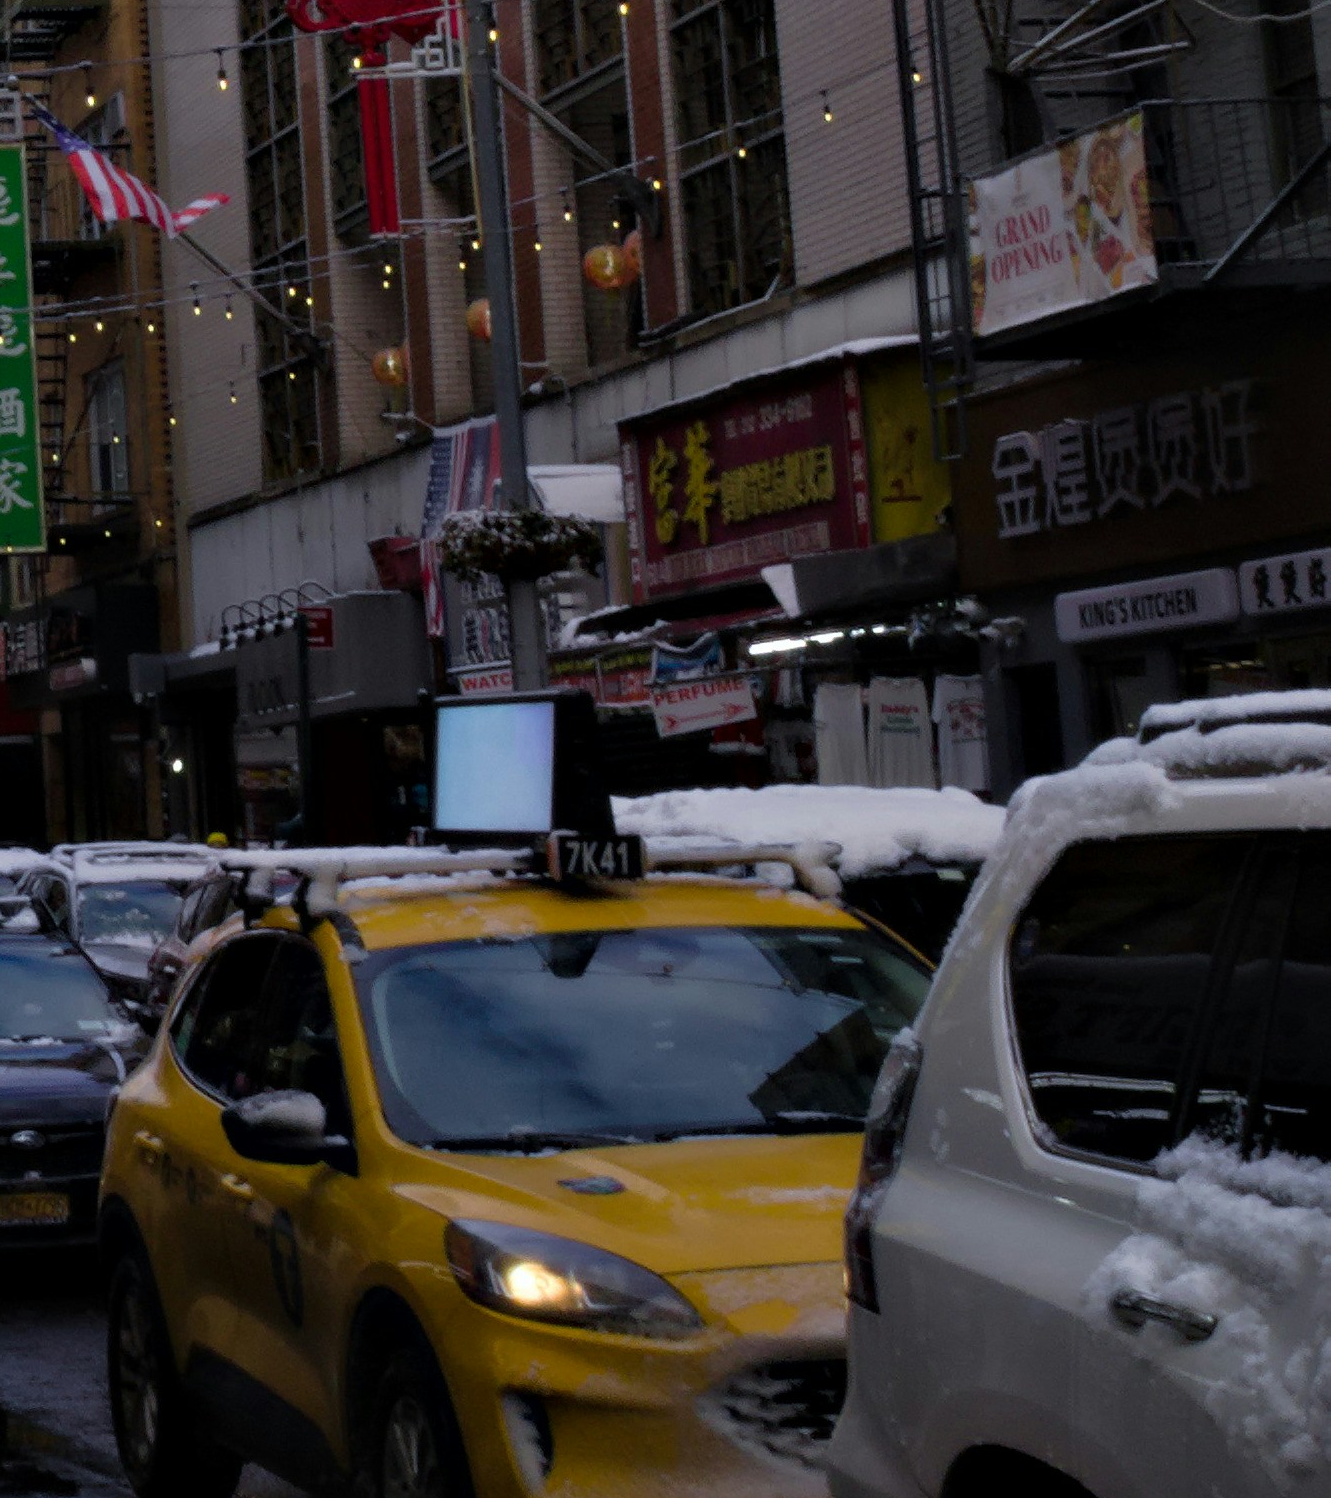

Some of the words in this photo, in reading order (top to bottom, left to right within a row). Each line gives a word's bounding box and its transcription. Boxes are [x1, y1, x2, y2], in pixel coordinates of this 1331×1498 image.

[994, 204, 1051, 248] GRAND
[991, 234, 1063, 285] OPENING
[1078, 595, 1130, 629] KING'S
[1131, 587, 1199, 622] KITCHEN
[652, 677, 744, 707] PERFUME
[563, 839, 629, 876] 7K41
